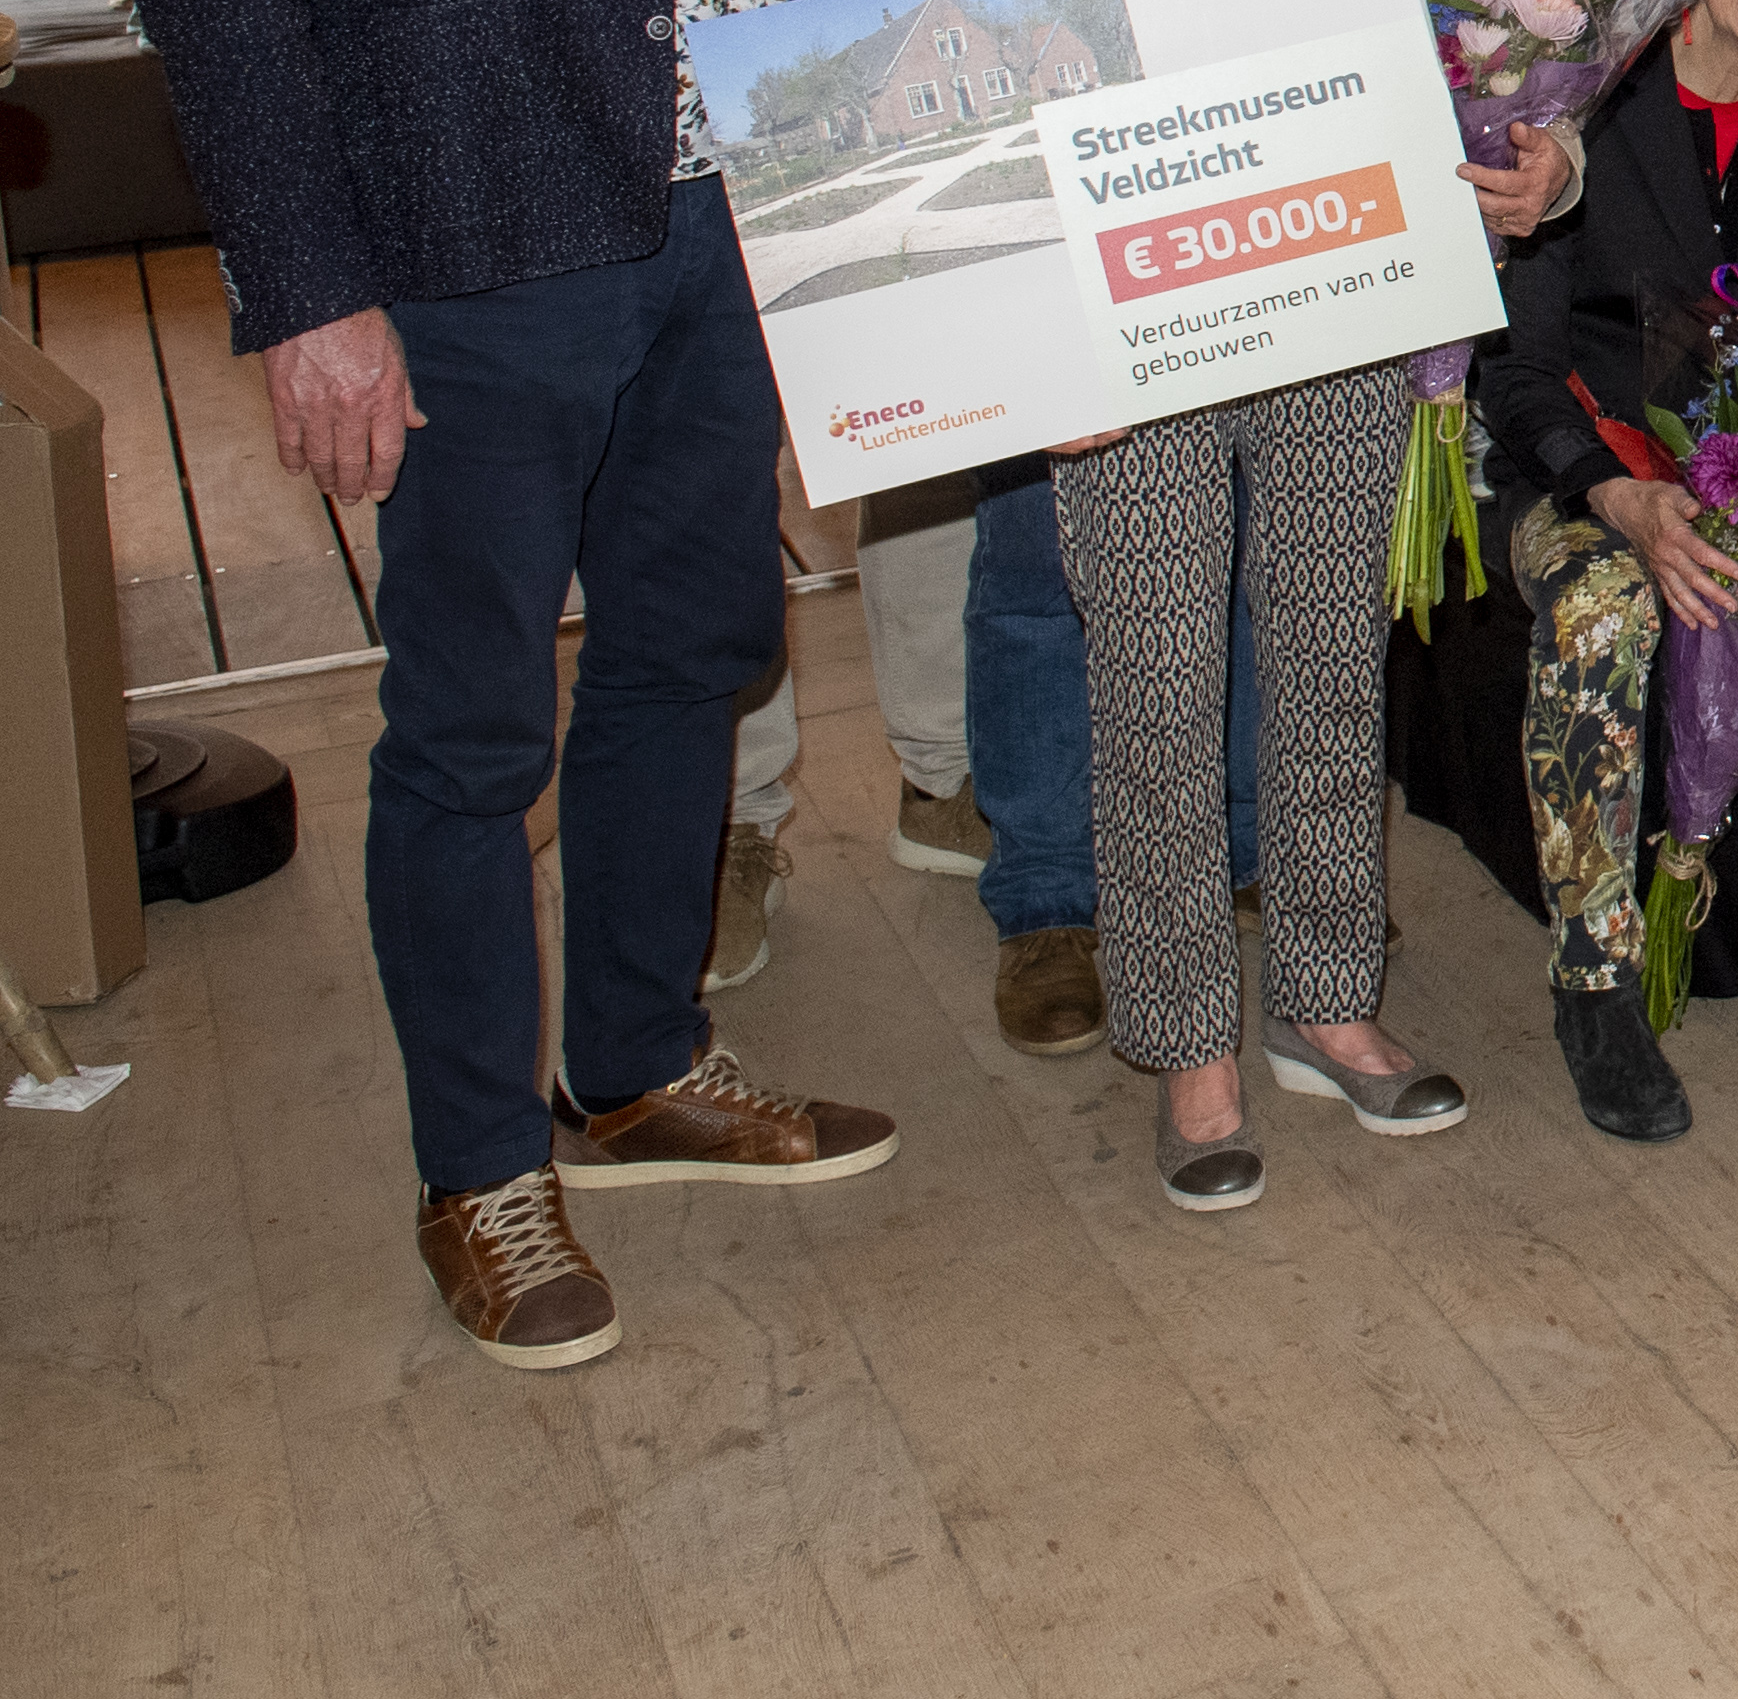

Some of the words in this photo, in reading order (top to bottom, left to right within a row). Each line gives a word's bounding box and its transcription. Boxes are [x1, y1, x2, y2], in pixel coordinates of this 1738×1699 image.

[1072, 66, 1366, 162] Streekmuseum
[1079, 139, 1264, 205] Veldzicht
[1174, 195, 1379, 271] 30.000,-
[1120, 283, 1320, 350] Verduurzamen
[1326, 272, 1376, 299] van
[1383, 257, 1416, 285] de
[1131, 327, 1275, 386] gebouwen
[845, 395, 925, 430] Eneco
[859, 400, 1007, 452] Luchterduinen
